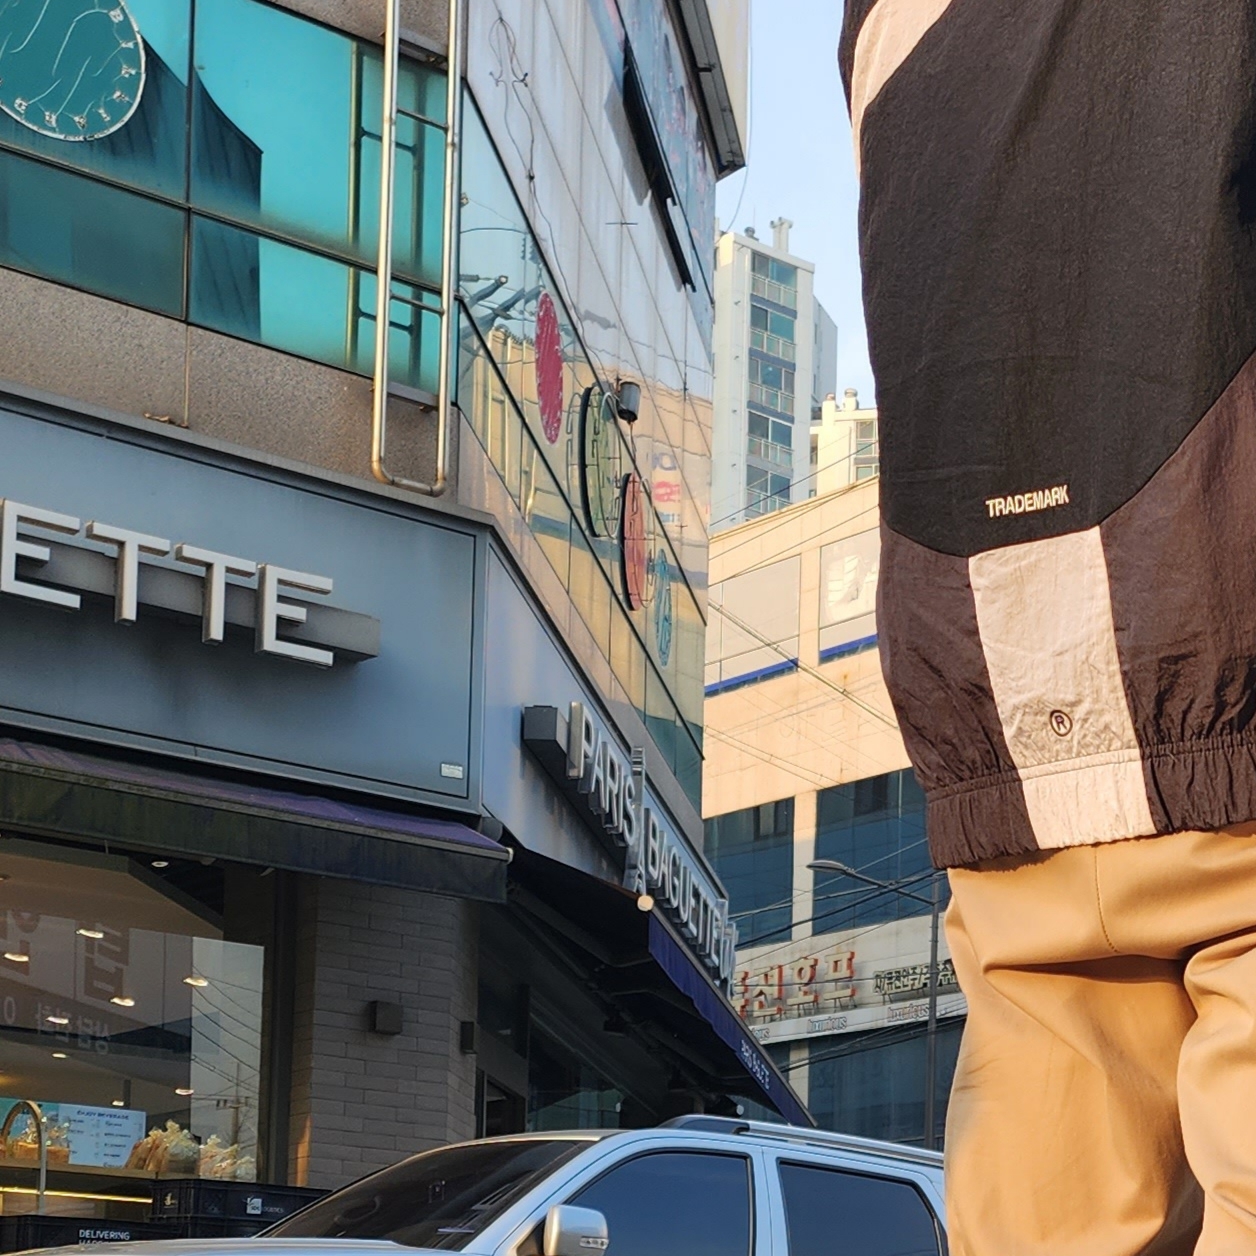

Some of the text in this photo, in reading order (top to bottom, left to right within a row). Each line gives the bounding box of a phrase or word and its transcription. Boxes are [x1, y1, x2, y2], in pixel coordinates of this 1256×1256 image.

[985, 484, 1070, 518] TRADEMARK
[0, 497, 334, 668] ETTE
[566, 702, 722, 969] PARIS BAGUETTE
[79, 1229, 130, 1240] DELIVERING
